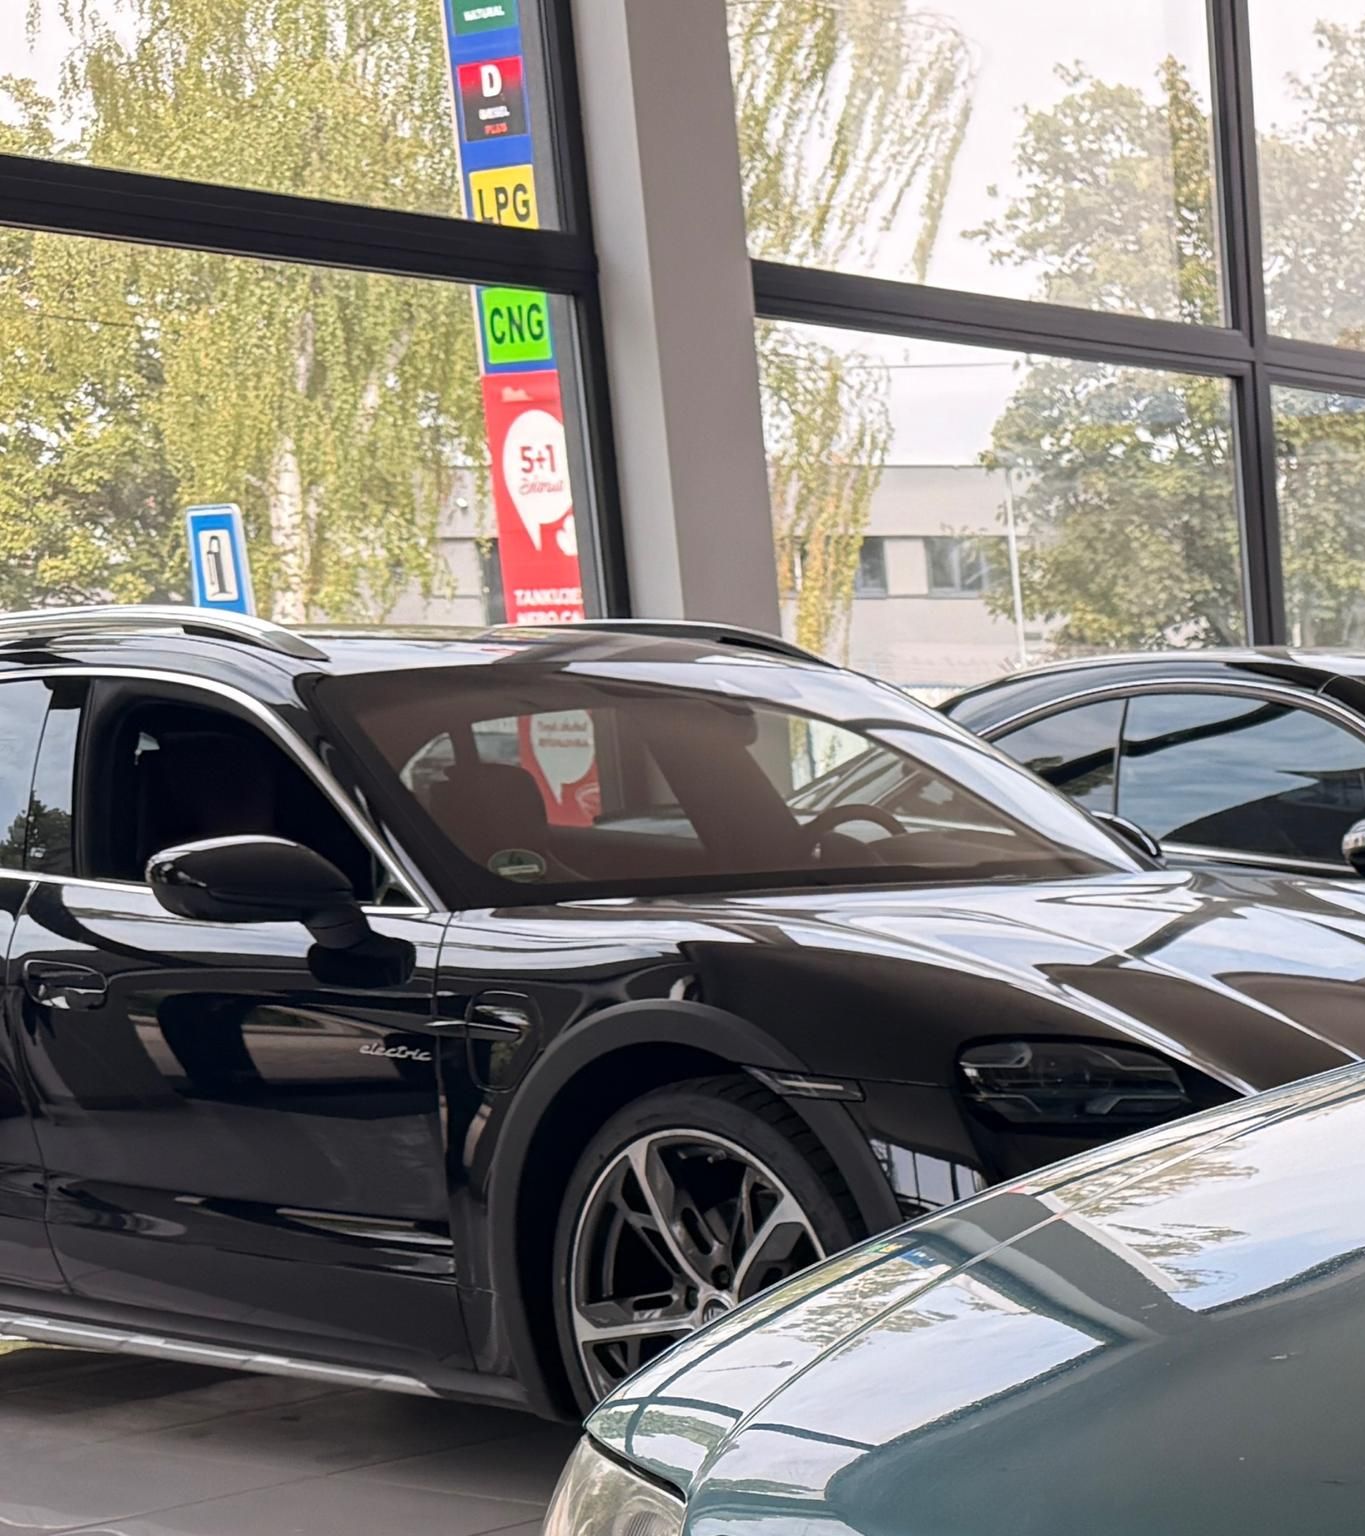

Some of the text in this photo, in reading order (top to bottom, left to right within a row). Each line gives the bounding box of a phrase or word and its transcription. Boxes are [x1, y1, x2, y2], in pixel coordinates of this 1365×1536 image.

[480, 64, 502, 97] D
[478, 183, 531, 225] LPG
[490, 303, 545, 345] CNG
[520, 444, 556, 474] 5+1
[359, 1043, 432, 1062] electric
